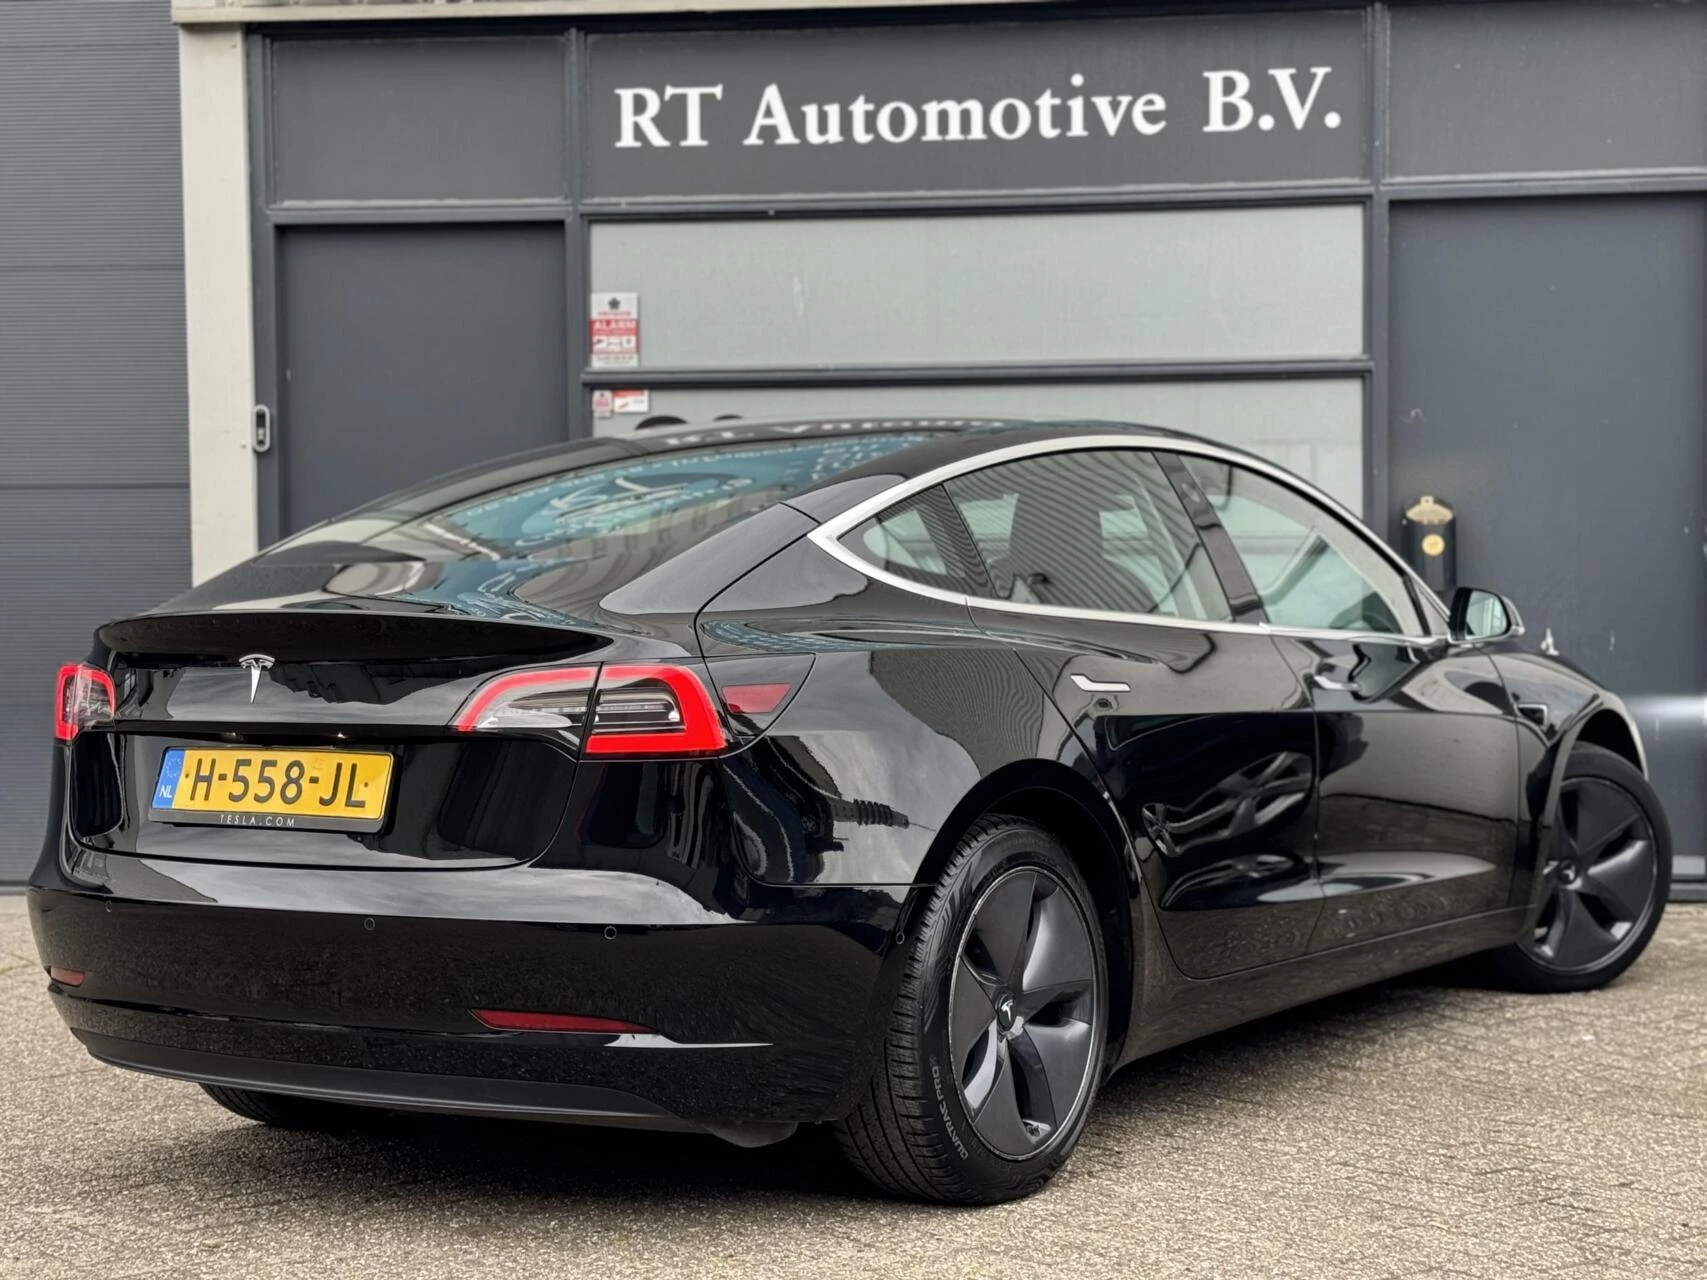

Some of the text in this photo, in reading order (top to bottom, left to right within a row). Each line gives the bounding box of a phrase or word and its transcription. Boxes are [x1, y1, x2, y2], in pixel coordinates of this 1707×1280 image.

[615, 66, 1341, 148] RT Automotive B.V.
[159, 785, 173, 798] NL
[189, 757, 366, 808] H-558-JL
[219, 814, 295, 827] TESLA.COM
[939, 1100, 969, 1160] QUATRAC
